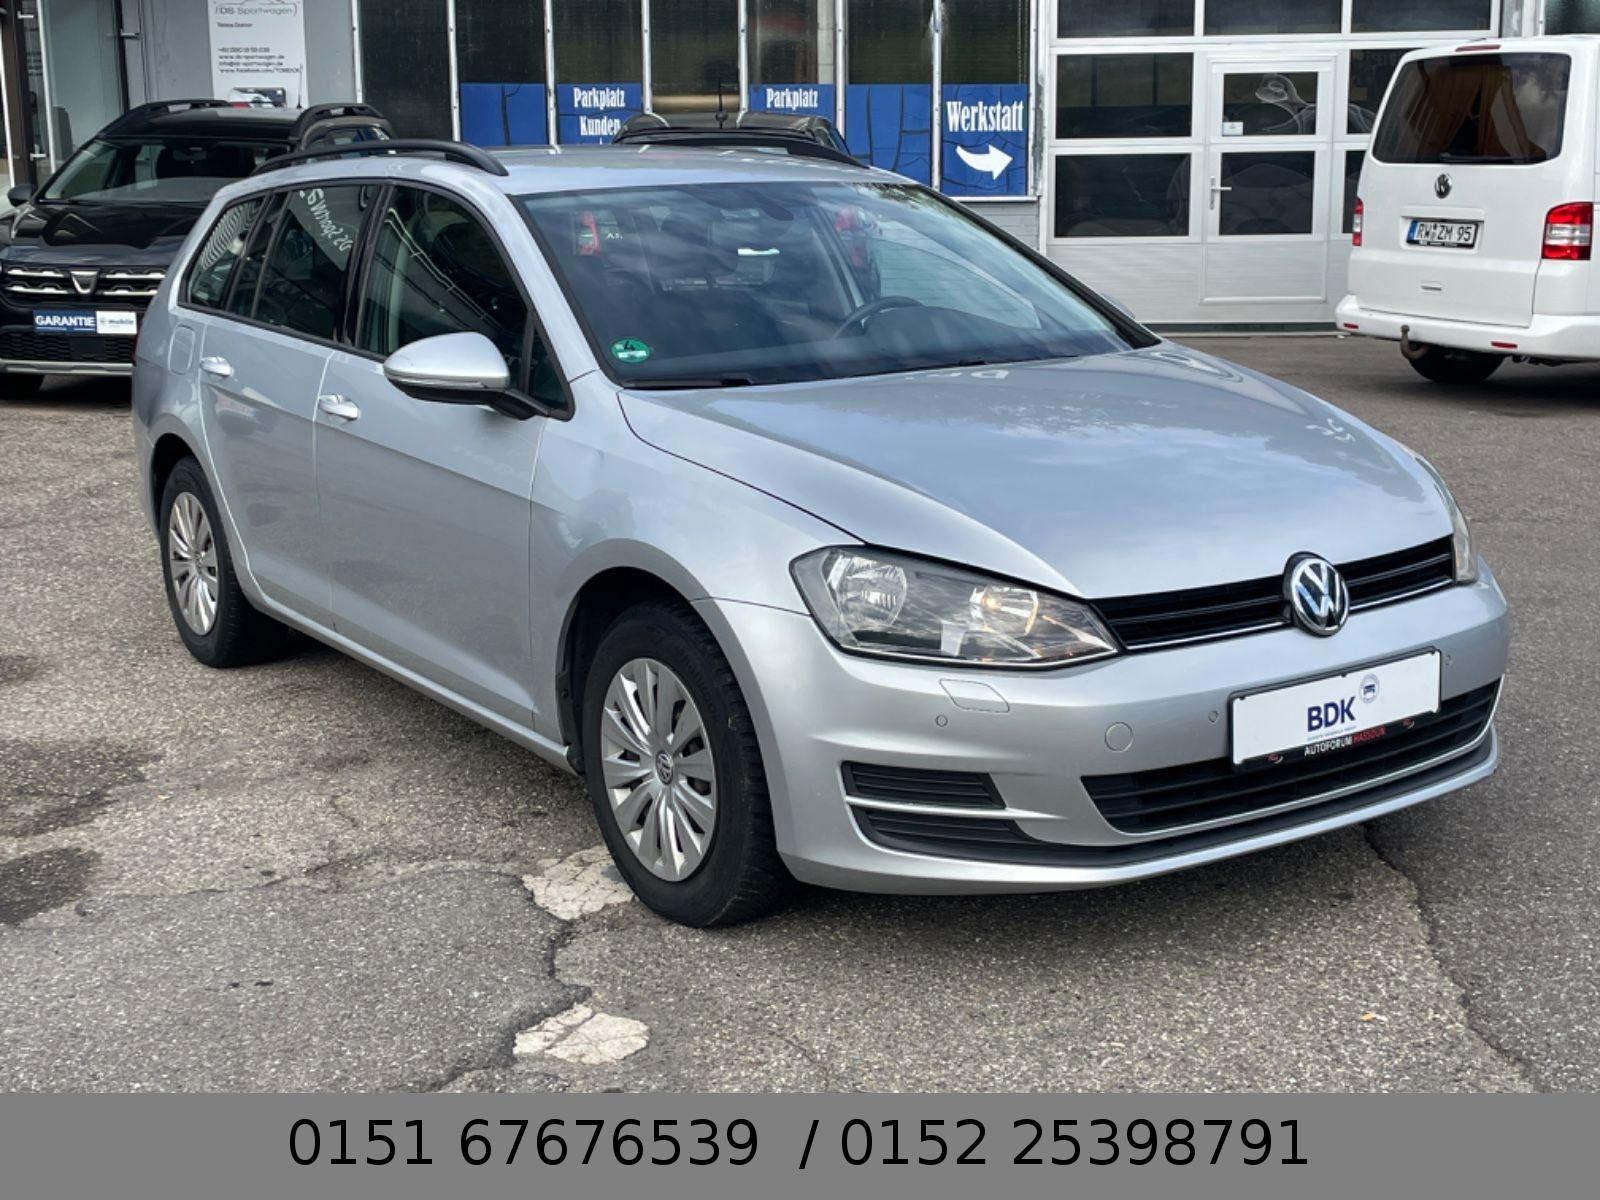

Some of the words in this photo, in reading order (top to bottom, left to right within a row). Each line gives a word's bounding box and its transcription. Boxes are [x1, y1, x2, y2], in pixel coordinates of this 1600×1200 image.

[573, 87, 626, 110] Parkplatz
[766, 87, 818, 110] Parkplatz
[580, 115, 621, 136] Kunden
[946, 100, 1024, 132] Werkstatt
[1457, 226, 1472, 242] 95
[35, 315, 95, 326] GARANTIE
[1307, 696, 1356, 732] BDK
